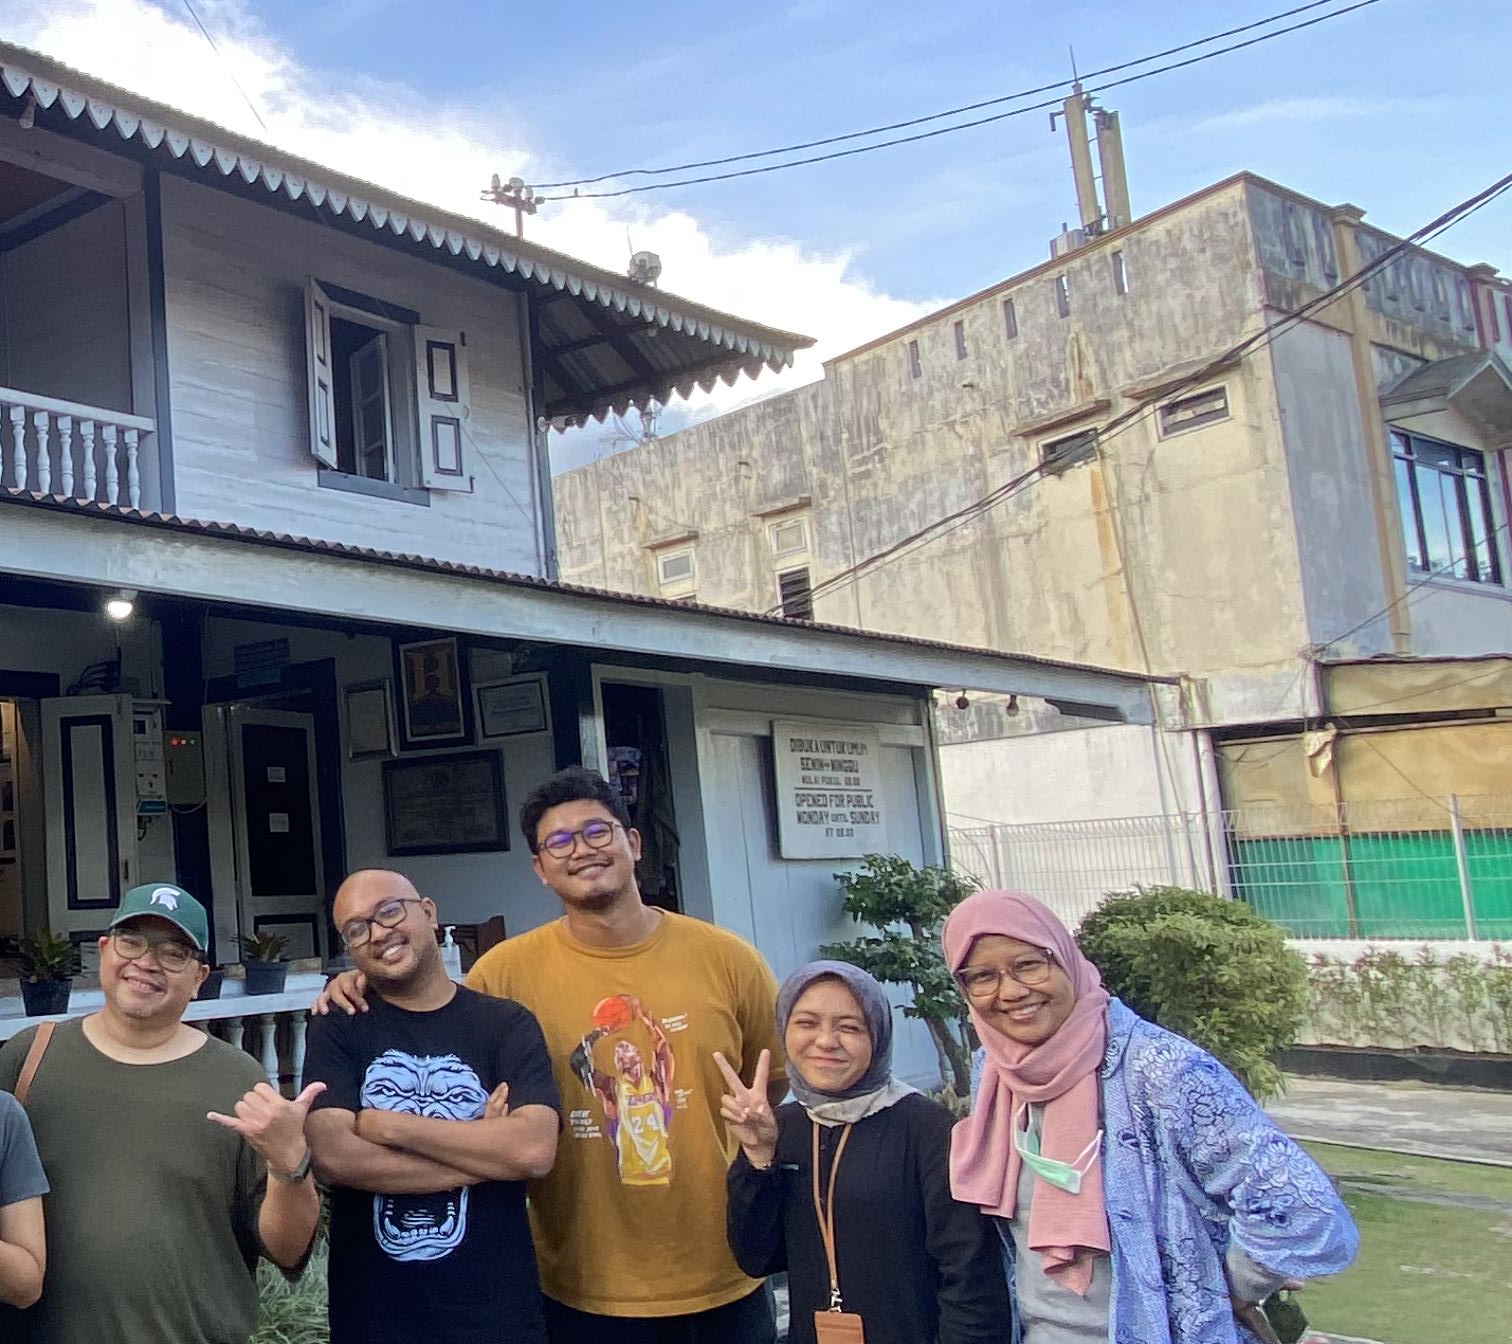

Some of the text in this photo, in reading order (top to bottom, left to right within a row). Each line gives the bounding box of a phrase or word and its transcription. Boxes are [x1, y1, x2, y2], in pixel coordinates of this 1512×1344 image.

[795, 793, 828, 807] OPENED
[829, 794, 845, 808] FOR
[796, 811, 829, 825] MONDAY
[849, 811, 880, 825] SUNDAY
[631, 1113, 659, 1134] 24
